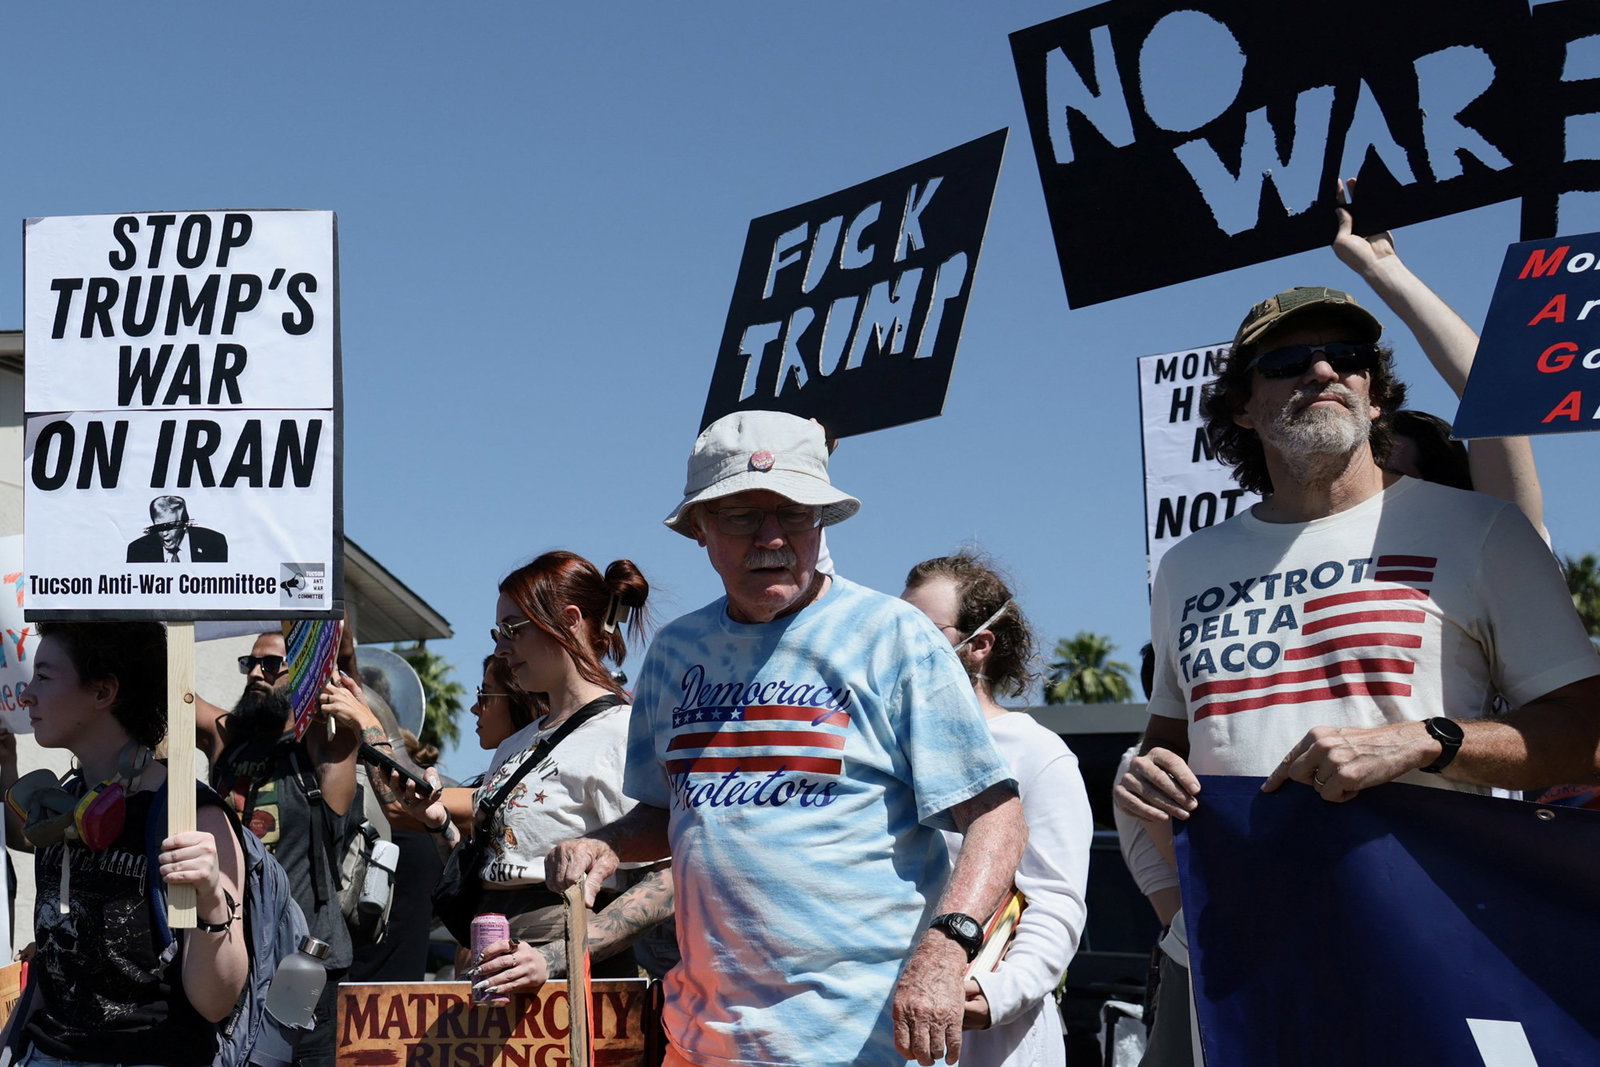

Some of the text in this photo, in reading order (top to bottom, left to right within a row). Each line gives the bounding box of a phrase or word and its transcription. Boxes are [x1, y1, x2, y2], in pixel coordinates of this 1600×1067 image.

[1046, 9, 1247, 164] NO
[1173, 44, 1515, 238] WAR
[108, 213, 253, 271] STOP
[50, 268, 318, 339] TRUMP'S
[117, 343, 248, 406] WAR
[31, 419, 322, 491] ON IRAN
[30, 573, 277, 595] Tucson Anti-War Committee
[1181, 557, 1373, 622] FOXTROT
[1178, 604, 1298, 652] DELTA
[1180, 640, 1281, 683] TACO
[672, 664, 852, 727] Democracy
[670, 758, 839, 811] Protectors
[489, 862, 528, 882] SHIT
